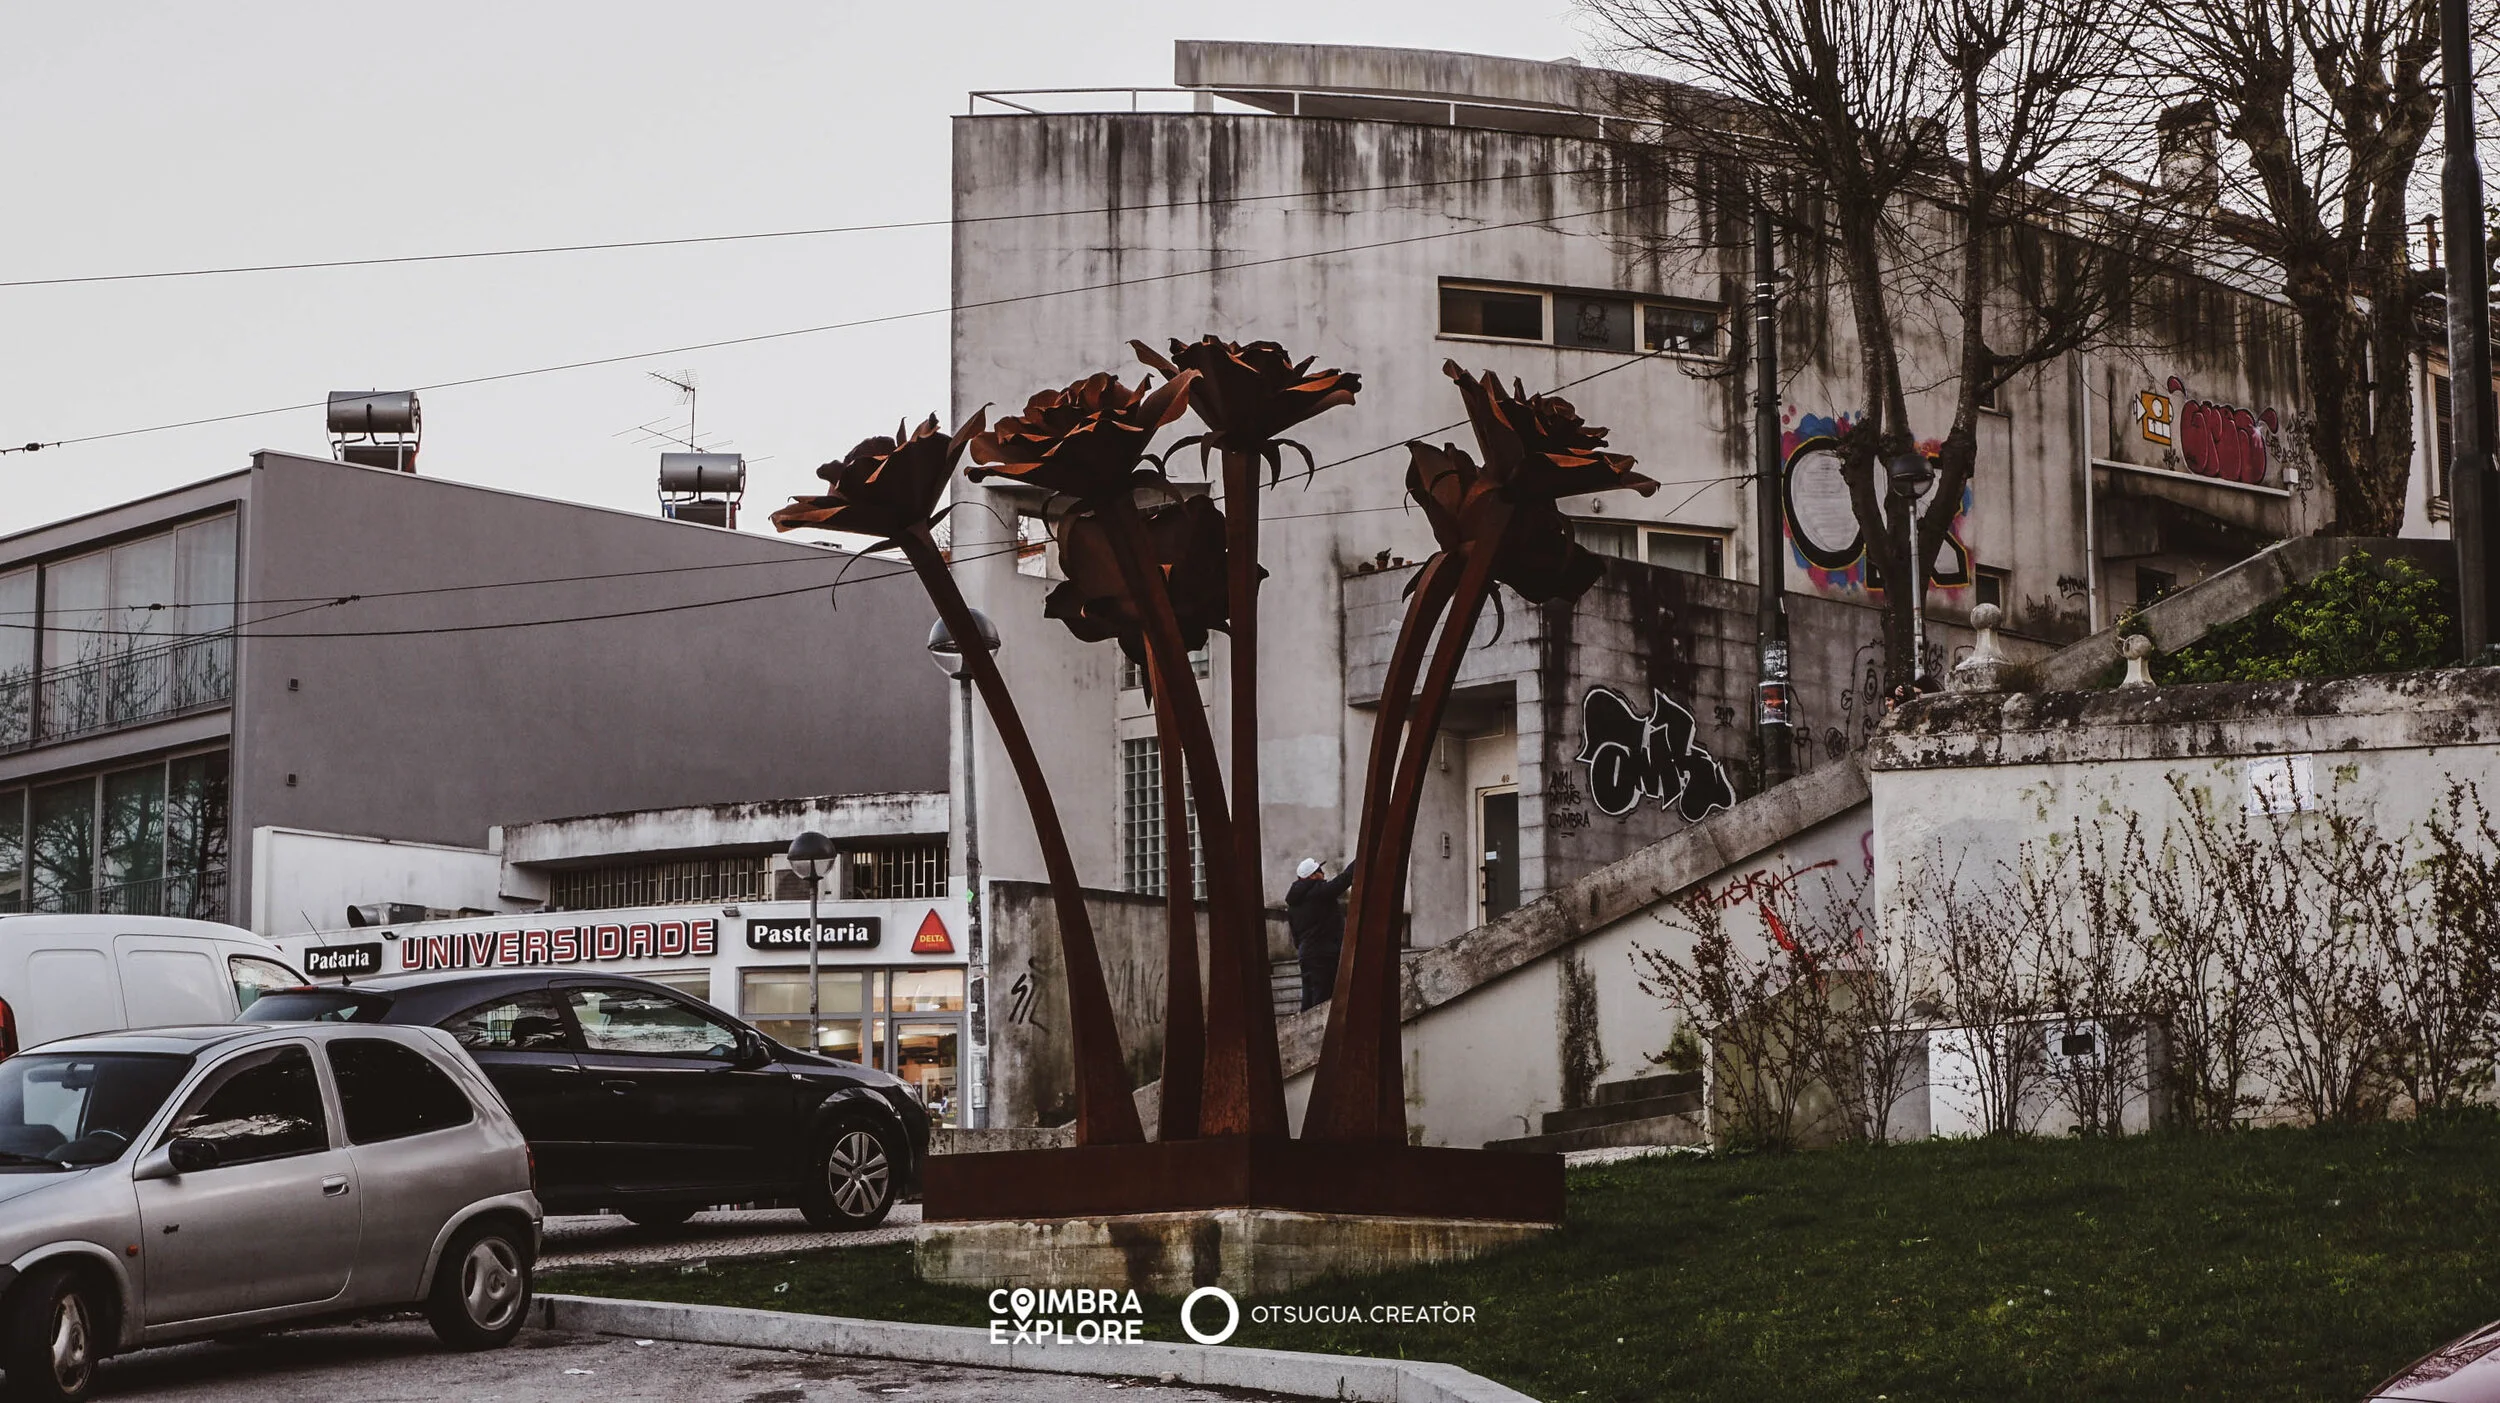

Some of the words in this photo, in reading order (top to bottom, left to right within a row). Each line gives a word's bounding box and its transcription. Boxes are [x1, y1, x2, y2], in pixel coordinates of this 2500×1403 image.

[754, 923, 869, 943] Pastelaria
[919, 934, 945, 943] DELTA
[401, 919, 714, 971] UNIVERSIDADE
[309, 949, 369, 970] Padaria
